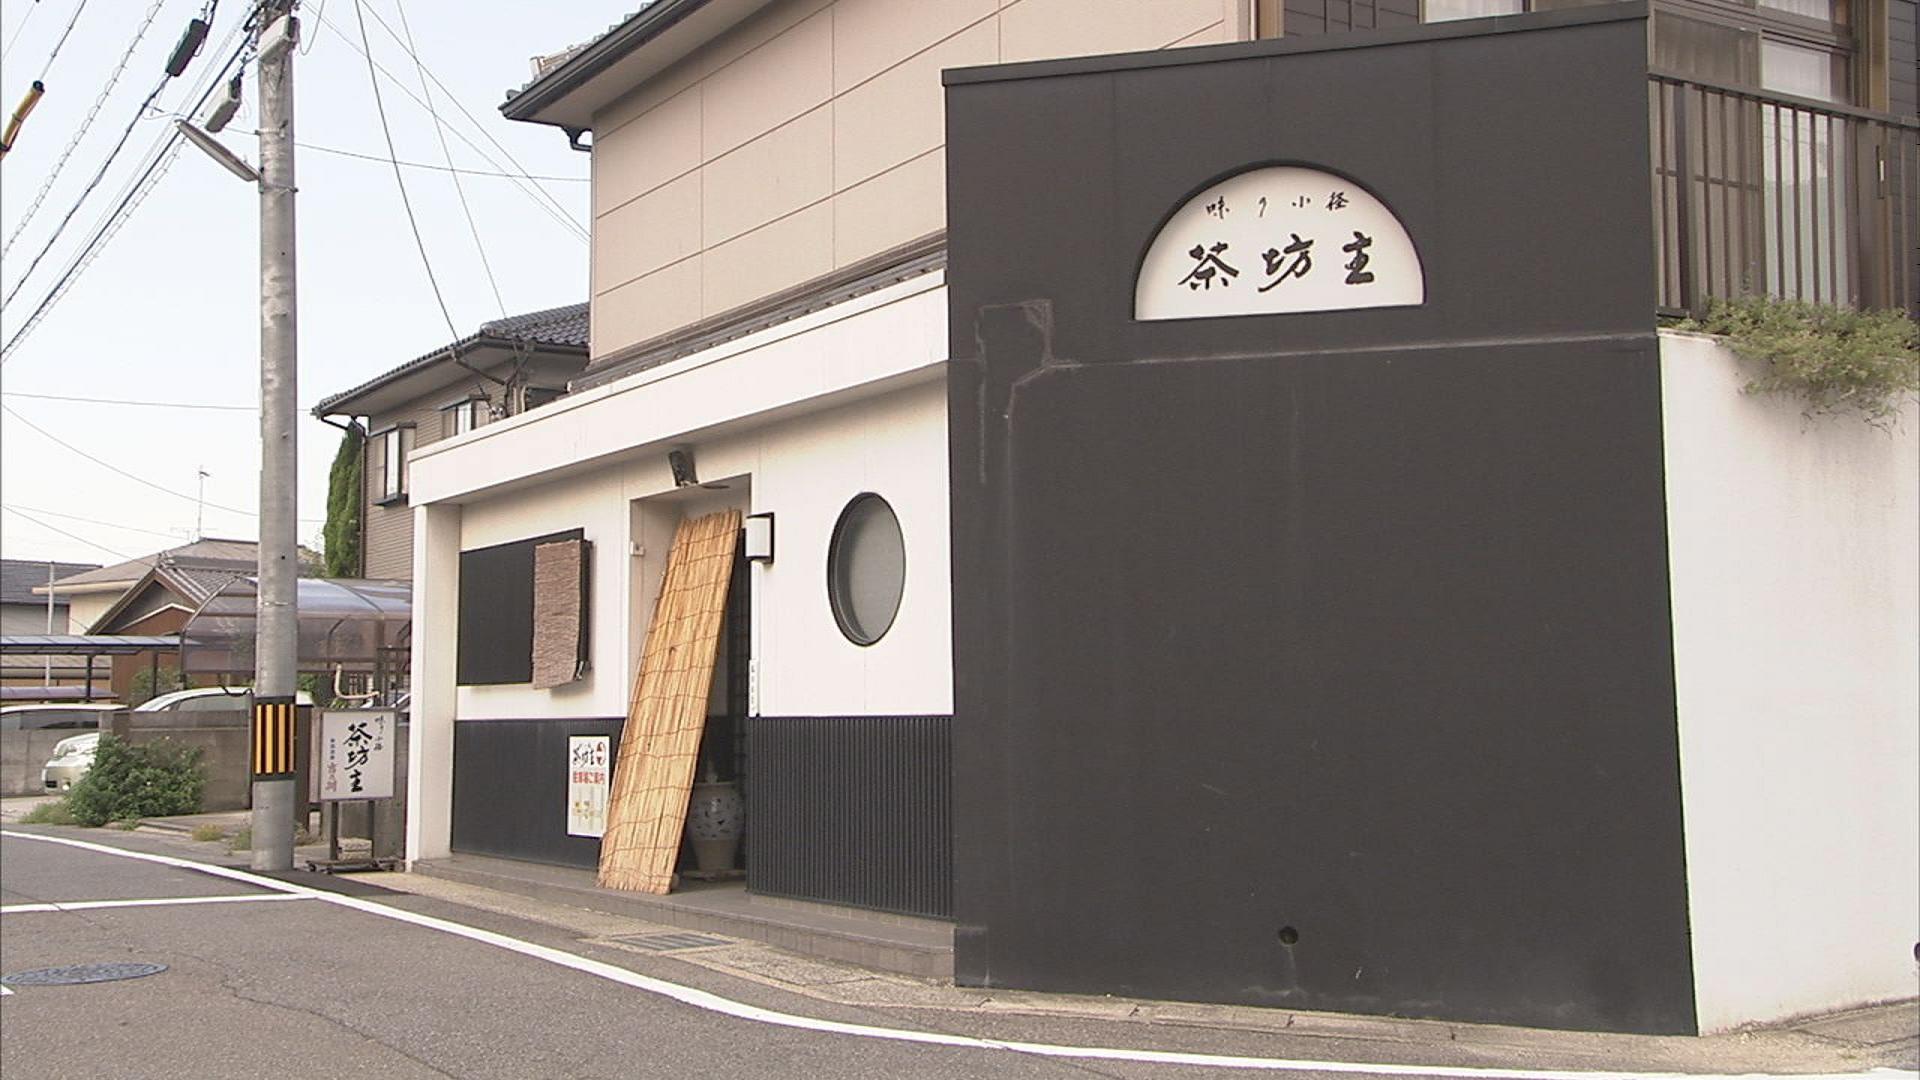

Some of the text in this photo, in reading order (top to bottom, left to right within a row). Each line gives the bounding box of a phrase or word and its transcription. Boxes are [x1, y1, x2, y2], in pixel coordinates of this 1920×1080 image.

[1177, 230, 1376, 294] 茶坊主
[343, 722, 373, 793] 茶坊主
